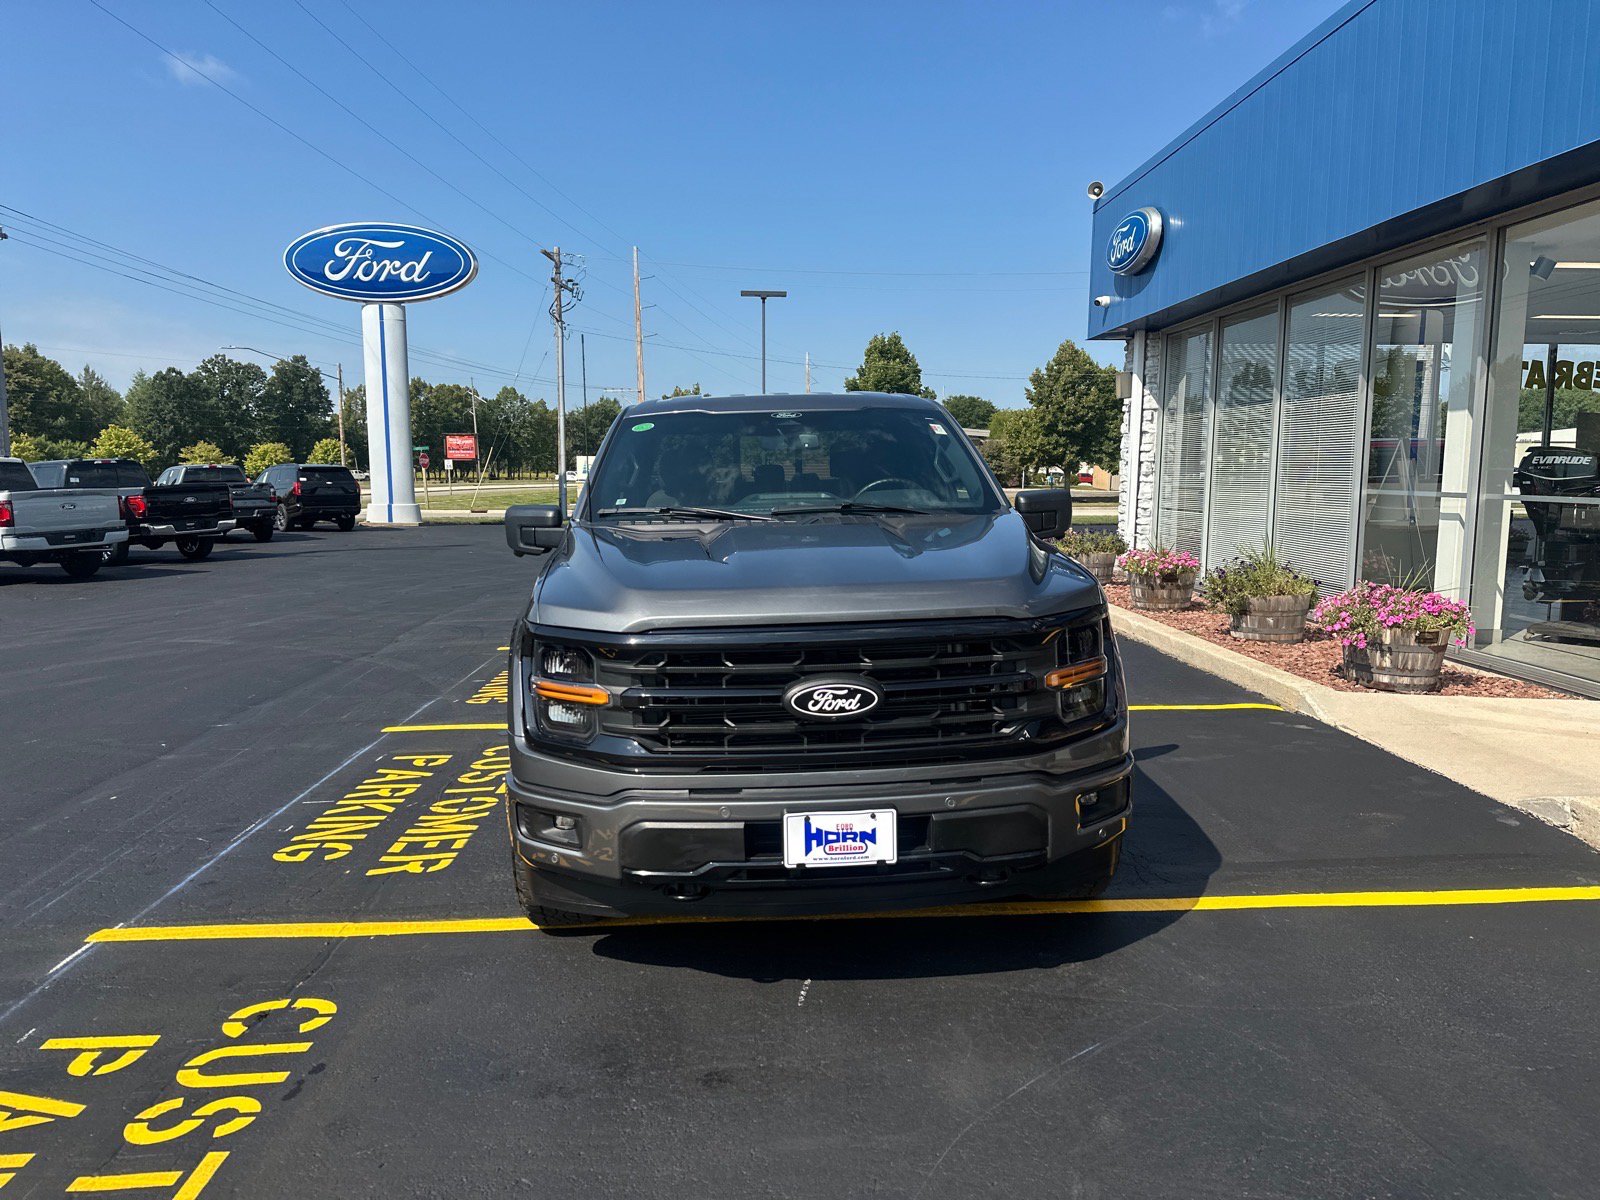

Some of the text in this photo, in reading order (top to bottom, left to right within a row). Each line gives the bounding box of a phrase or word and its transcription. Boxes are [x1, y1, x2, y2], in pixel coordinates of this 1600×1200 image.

[324, 238, 433, 282] Ford
[1111, 224, 1137, 263] Ford
[1531, 456, 1593, 465] EVINRUDE
[808, 689, 862, 712] Ford
[272, 754, 453, 862] PARKING
[804, 818, 877, 857] HORN
